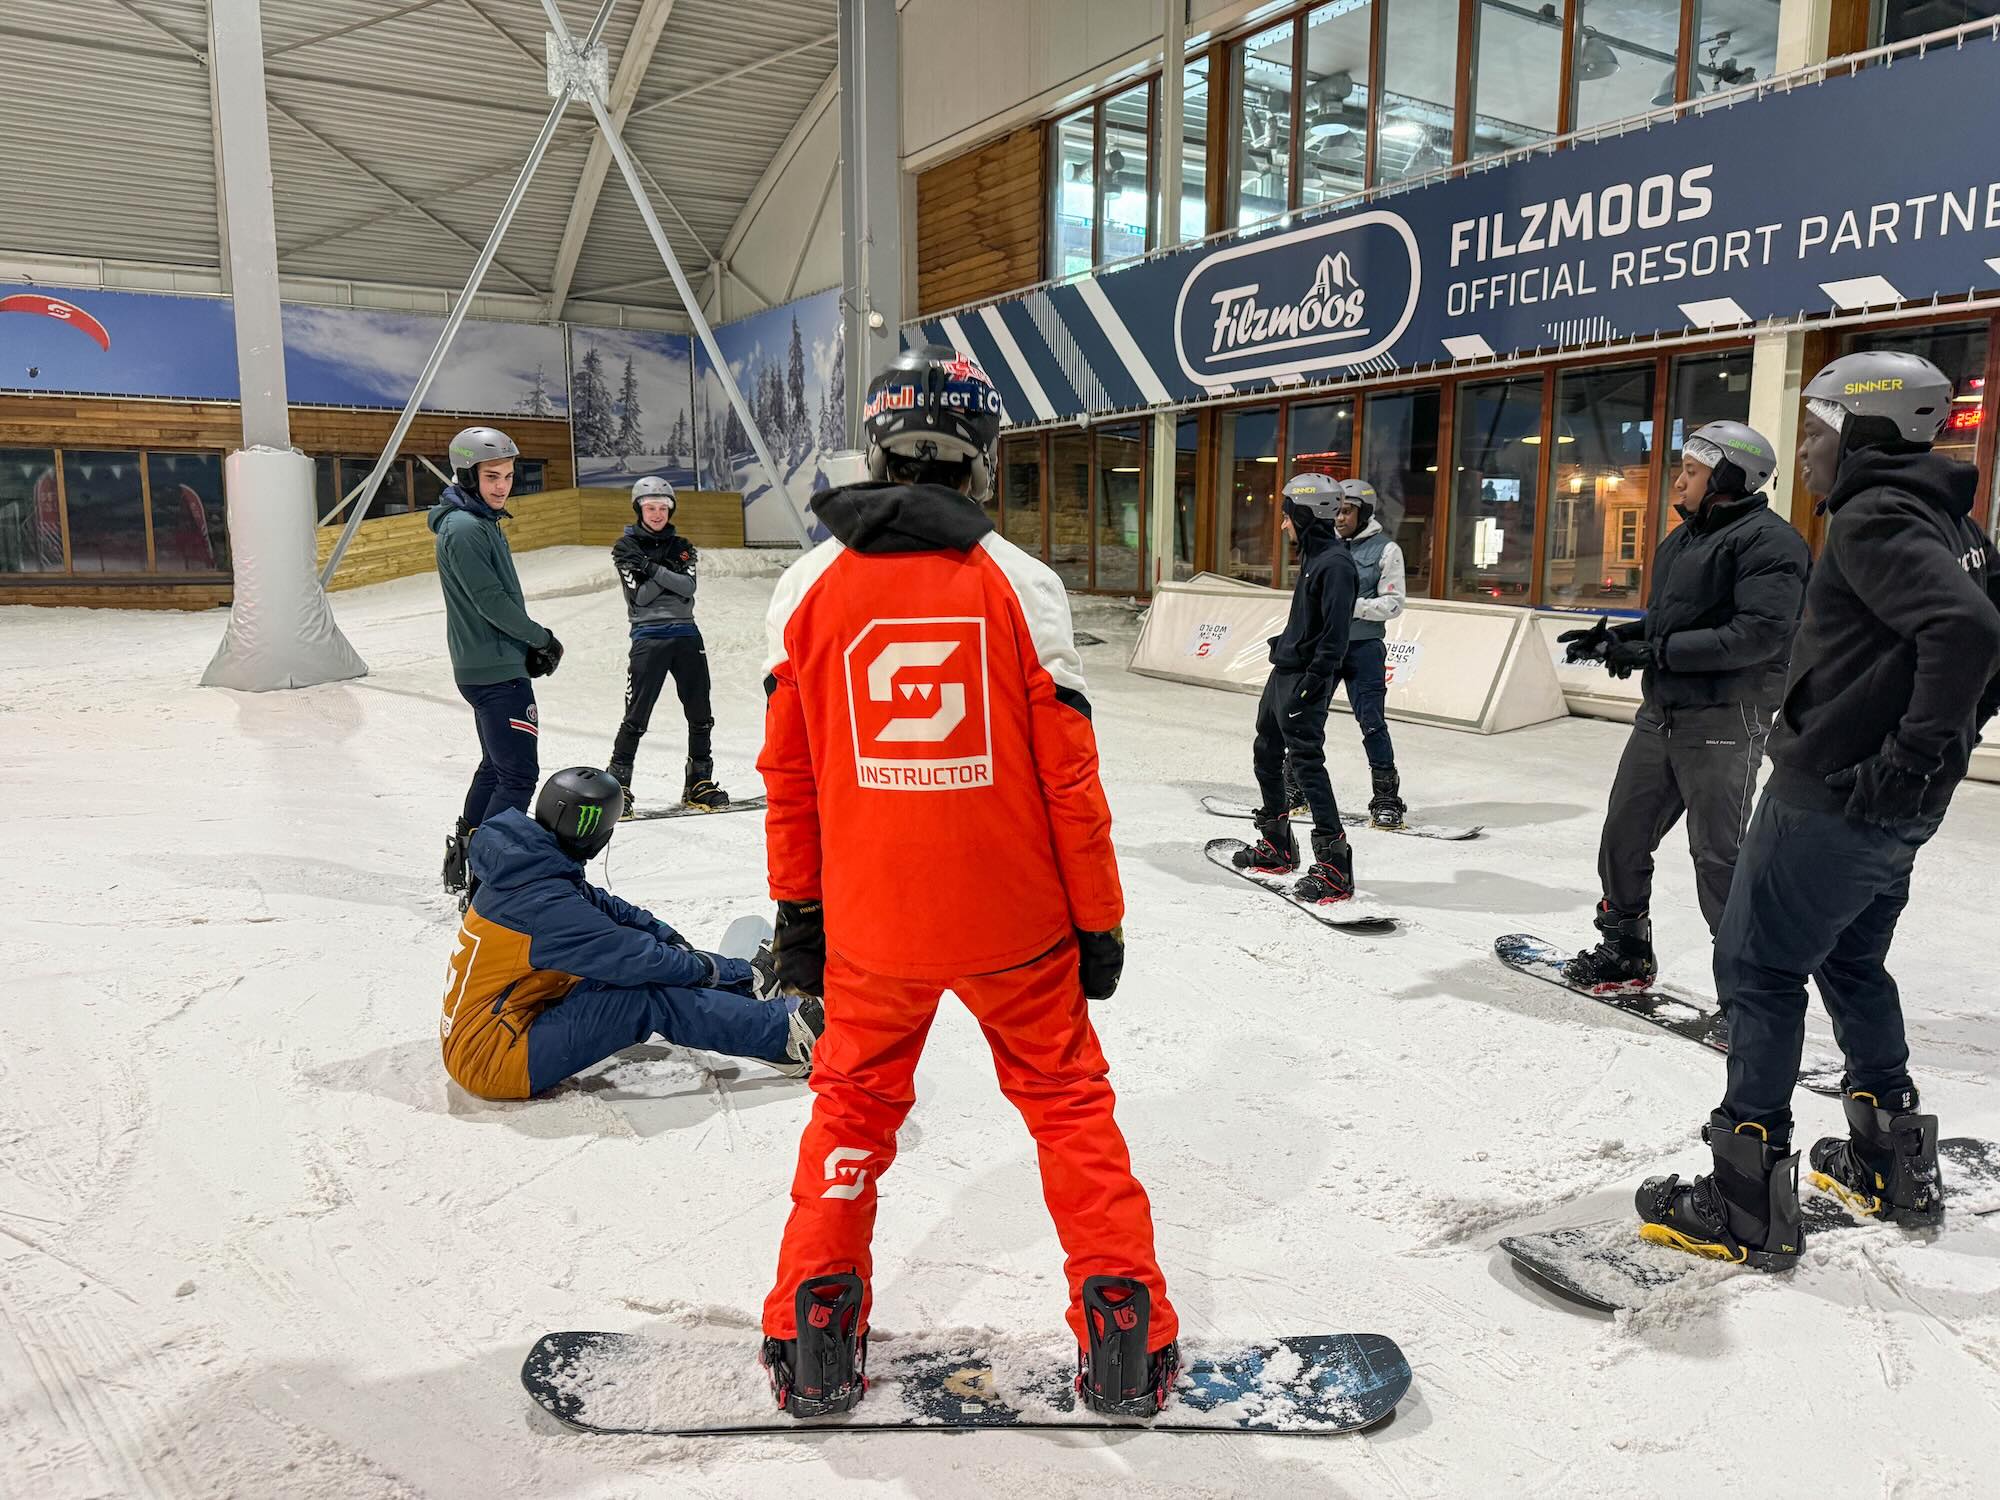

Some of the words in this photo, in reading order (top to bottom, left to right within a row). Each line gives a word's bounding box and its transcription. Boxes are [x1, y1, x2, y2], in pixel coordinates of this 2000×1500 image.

[1450, 164, 1713, 267] FILZMOOS
[1447, 260, 1597, 317] OFFICIAL
[1611, 223, 1783, 290] RESORT
[1211, 283, 1366, 353] Filzmoos
[1844, 378, 1903, 396] SINNER
[1386, 643, 1416, 655] WORL
[860, 763, 989, 786] INSTRUCTOR
